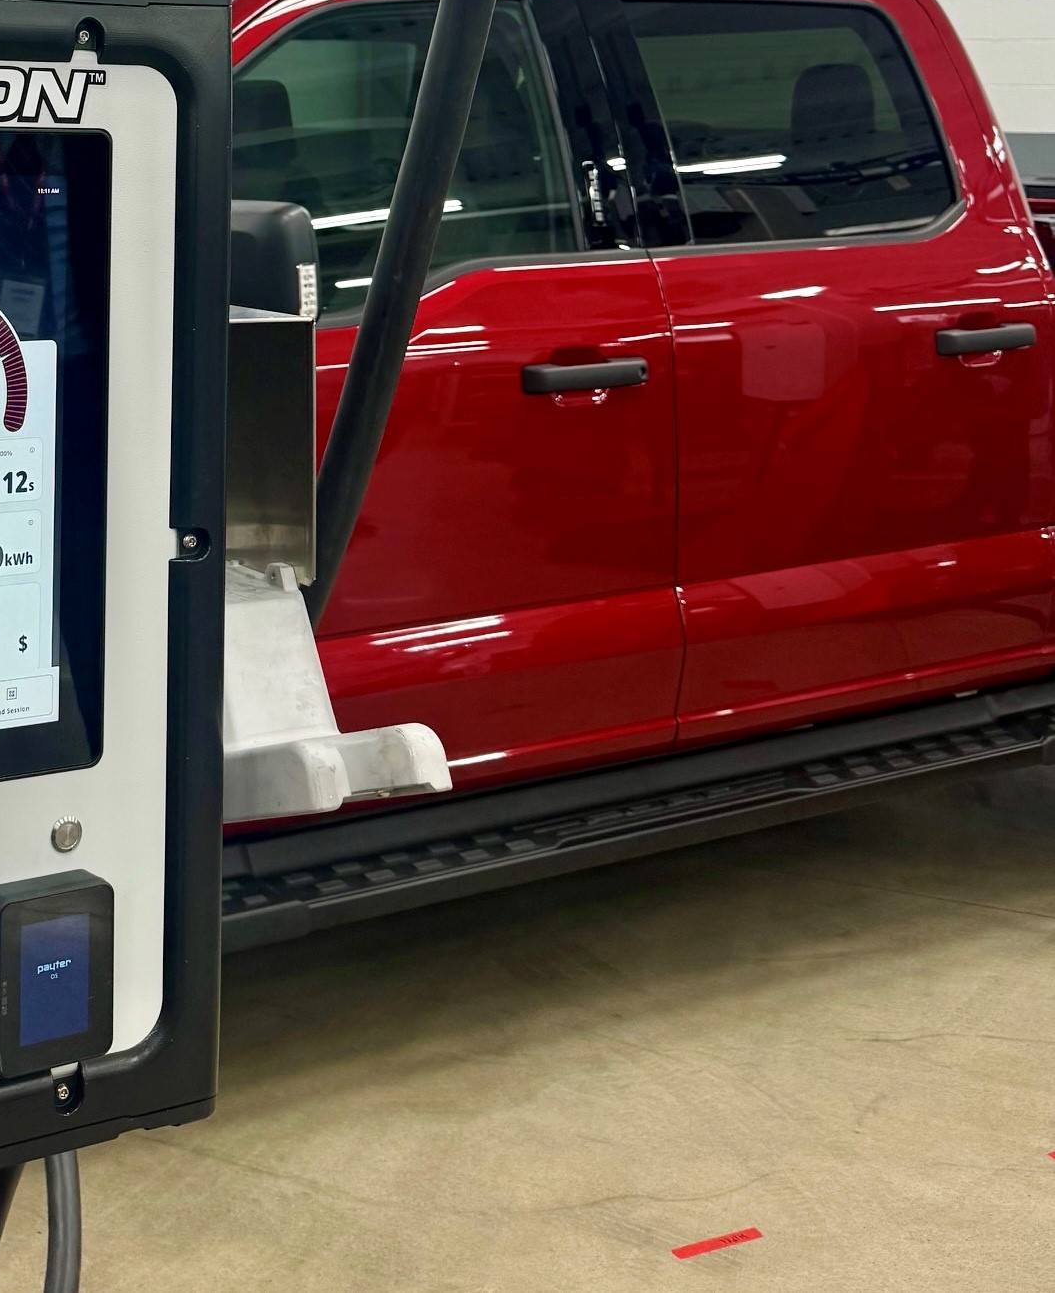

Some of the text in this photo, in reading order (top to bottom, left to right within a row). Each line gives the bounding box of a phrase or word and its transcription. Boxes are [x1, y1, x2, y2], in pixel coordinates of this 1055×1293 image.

[2, 470, 35, 494] 12s
[18, 634, 28, 653] $
[6, 706, 30, 715] Session
[37, 959, 72, 975] payter
